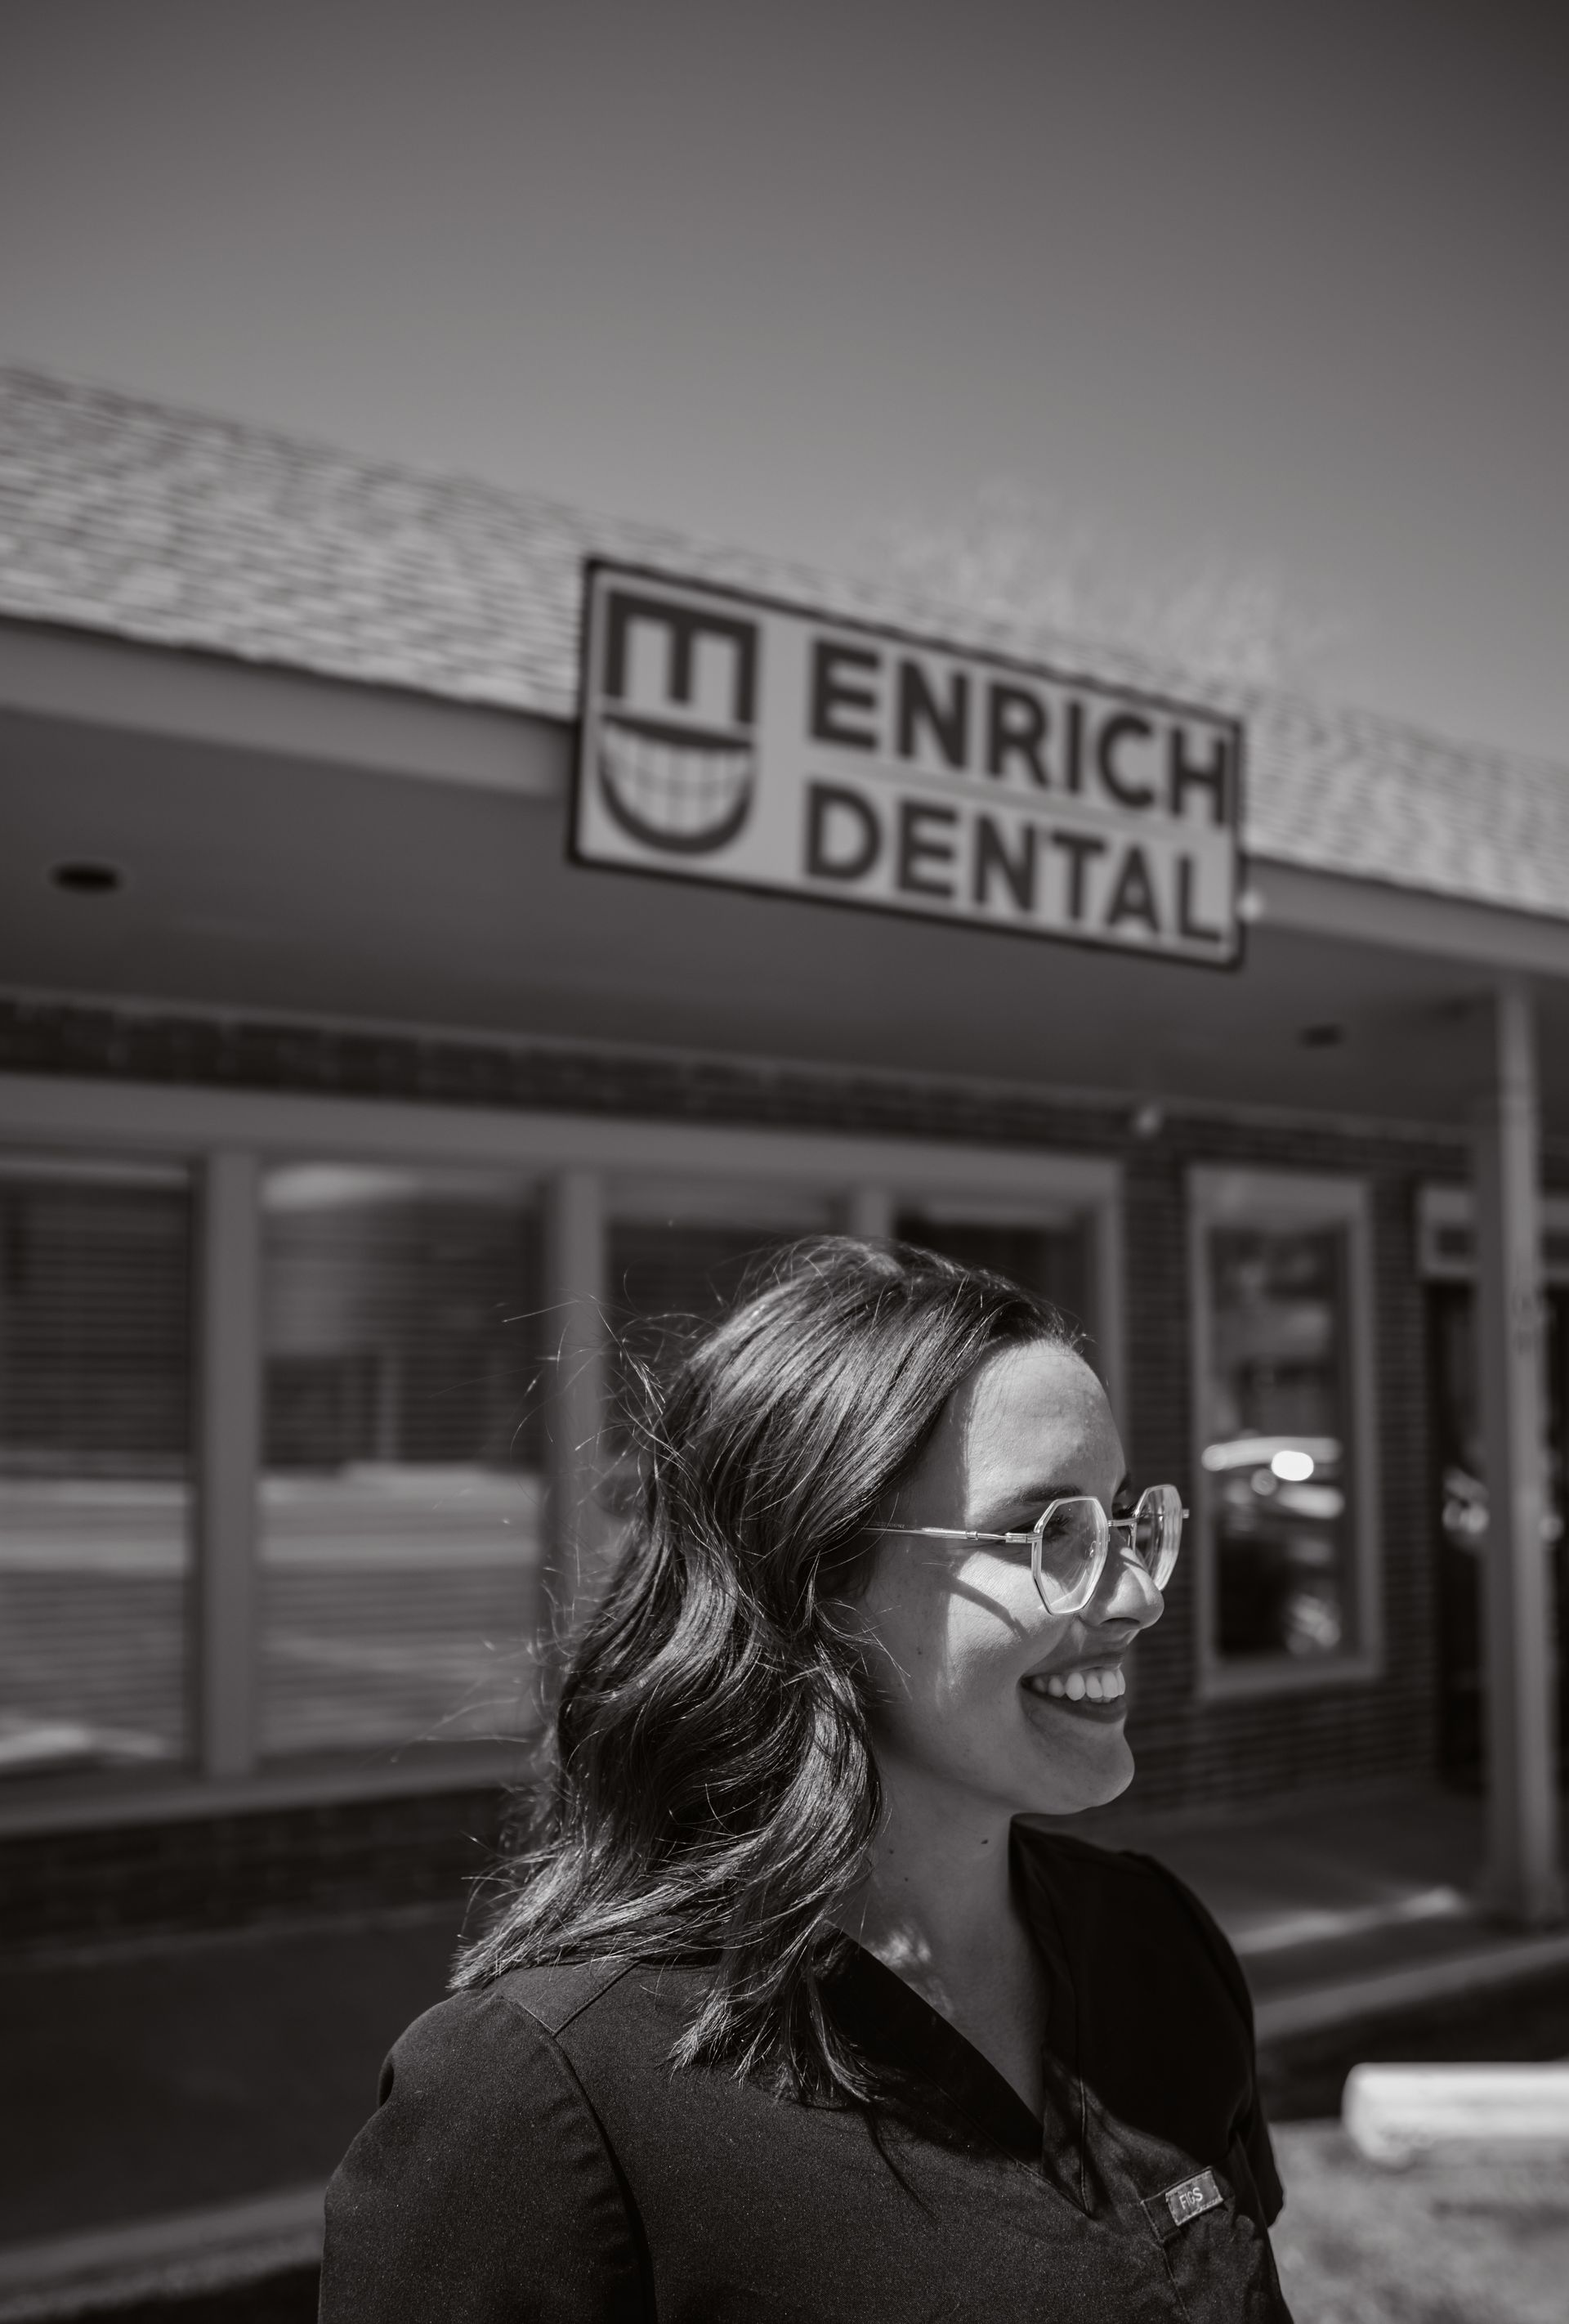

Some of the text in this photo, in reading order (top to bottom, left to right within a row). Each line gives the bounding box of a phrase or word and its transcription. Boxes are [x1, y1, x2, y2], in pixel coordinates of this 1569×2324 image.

[810, 638, 1229, 829] ENRICH
[804, 780, 1224, 946] DENTAL
[1179, 2187, 1203, 2210] FIGS
